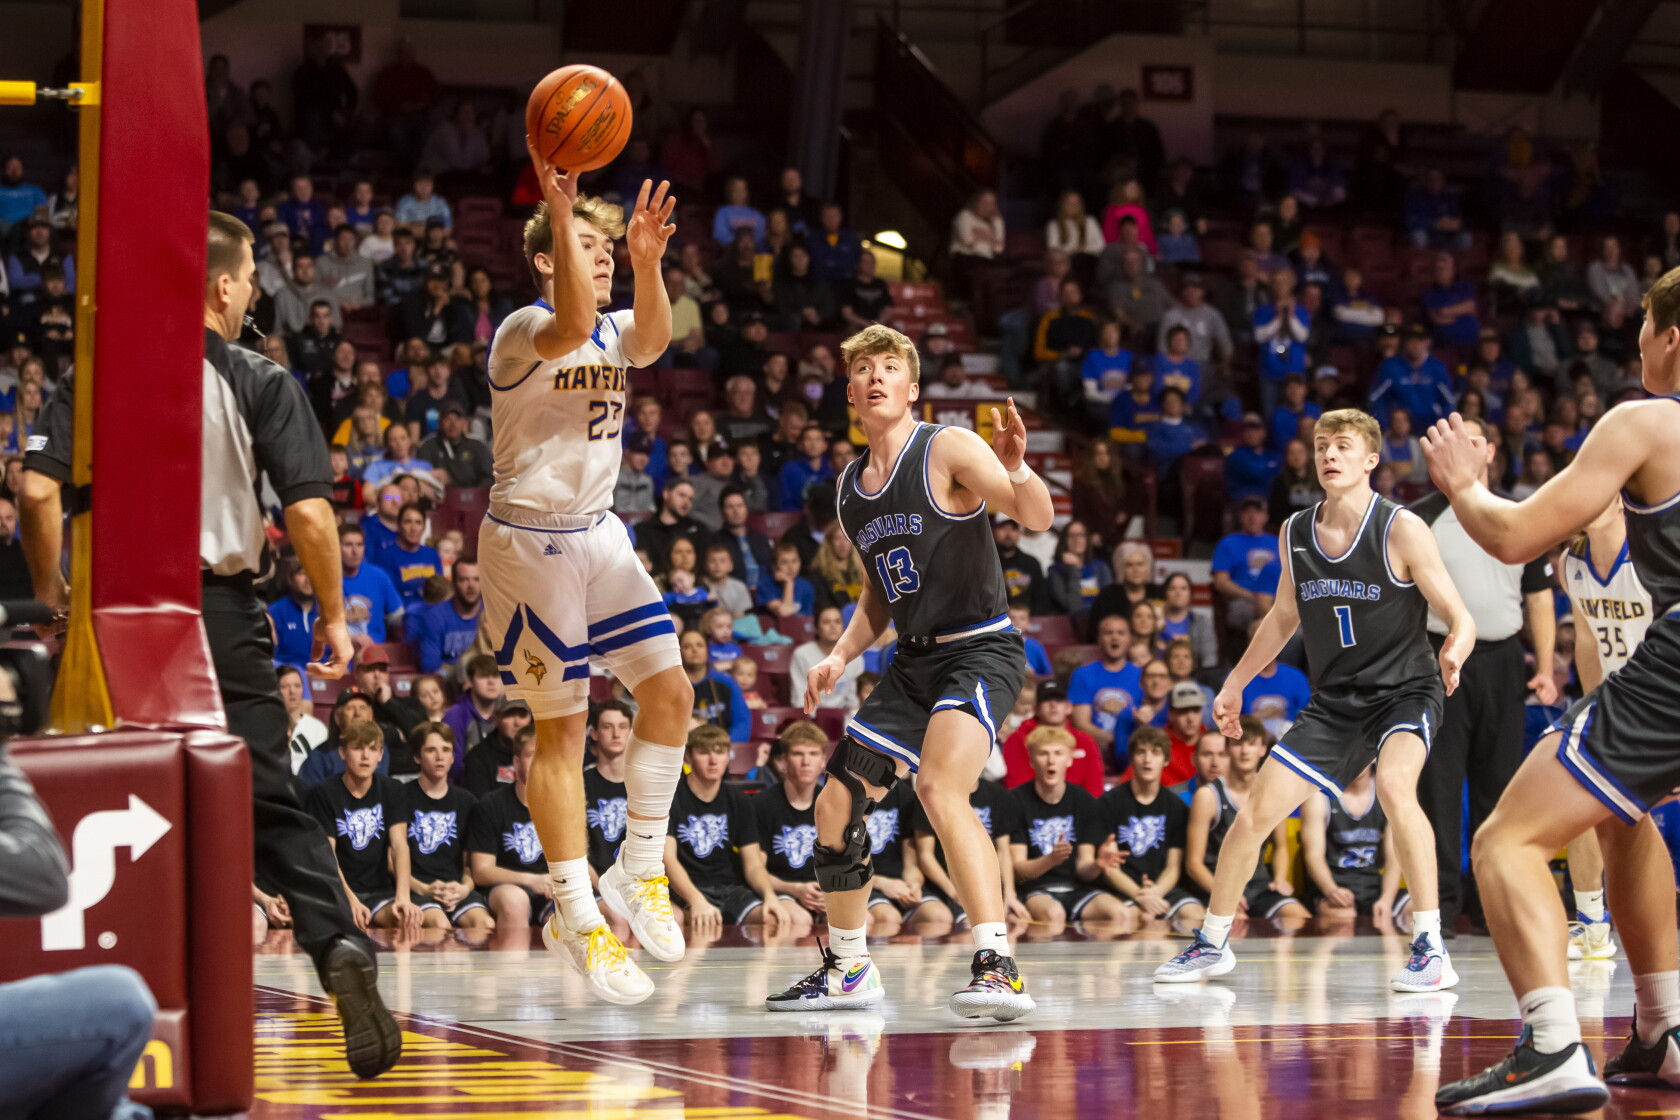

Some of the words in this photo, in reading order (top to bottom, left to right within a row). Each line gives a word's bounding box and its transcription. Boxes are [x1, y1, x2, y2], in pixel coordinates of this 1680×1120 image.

[545, 77, 597, 136] SPALDING
[586, 400, 623, 442] 23
[856, 513, 923, 553] JAGUARS
[875, 545, 920, 603] 13
[1299, 578, 1382, 602] JAGUARS
[1333, 605, 1357, 648] 1
[1596, 625, 1629, 658] 35
